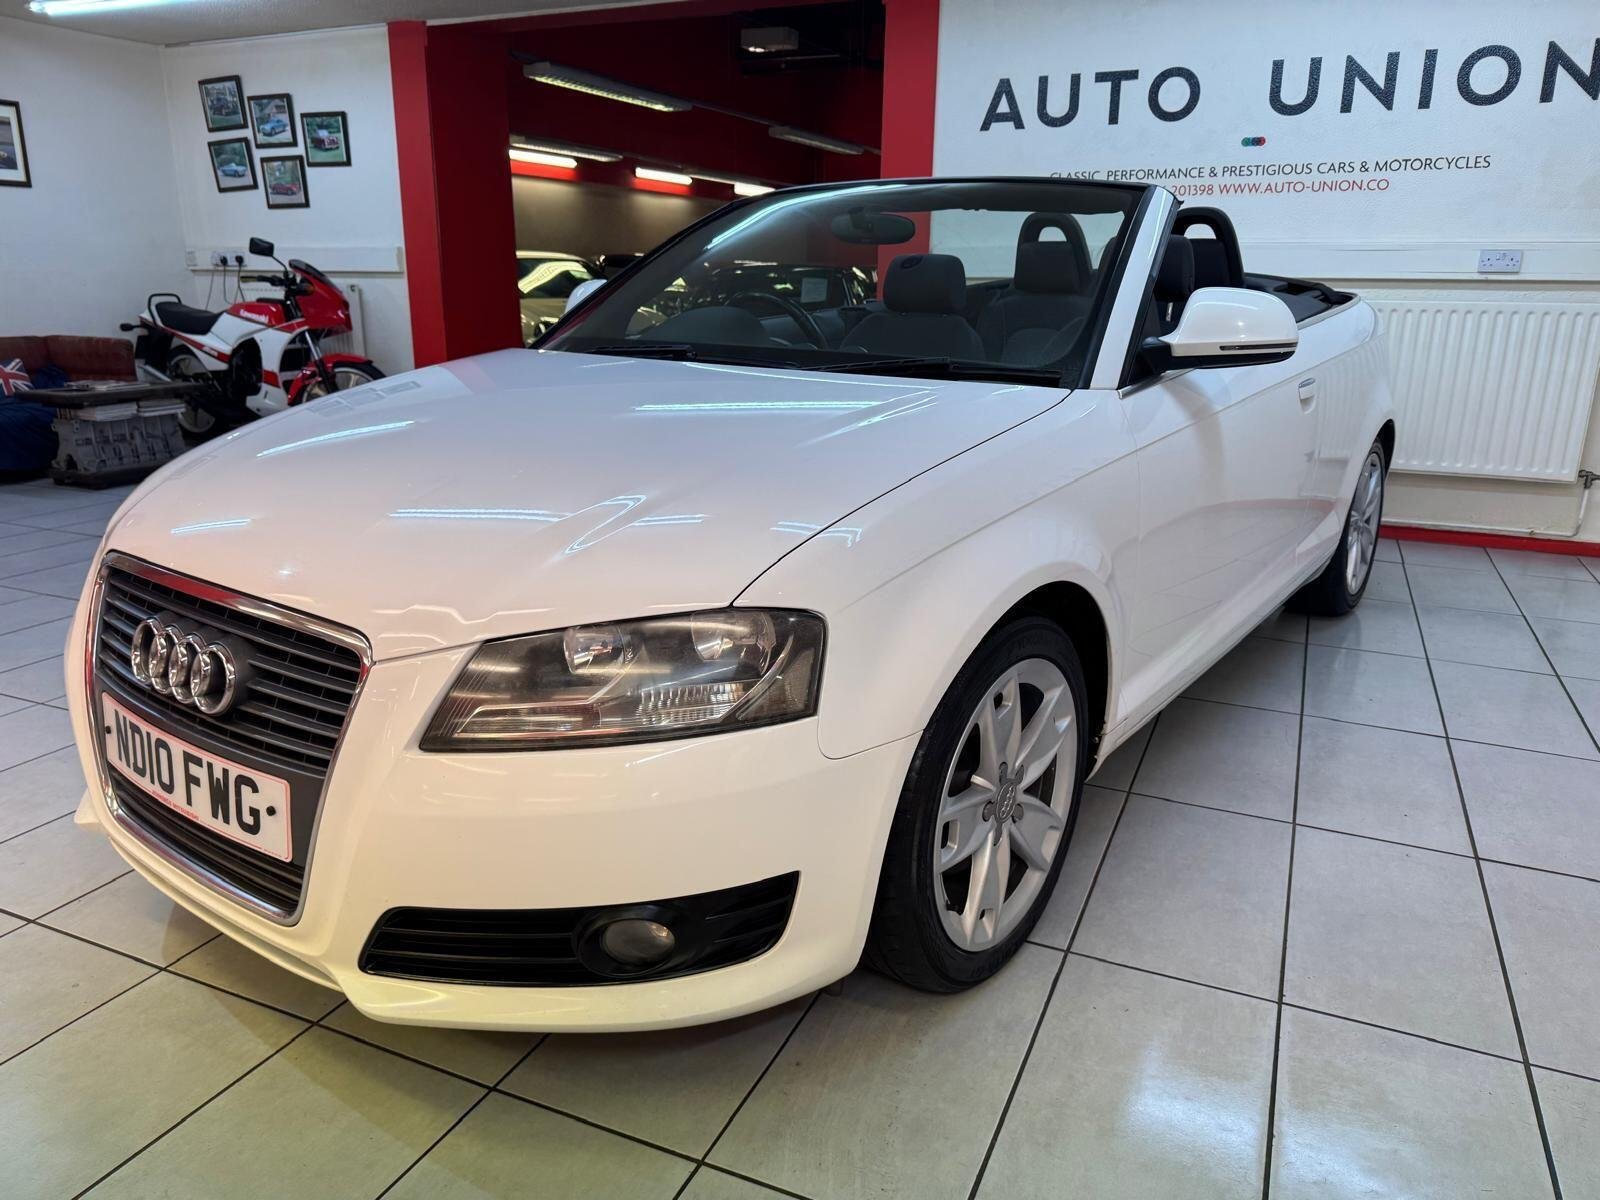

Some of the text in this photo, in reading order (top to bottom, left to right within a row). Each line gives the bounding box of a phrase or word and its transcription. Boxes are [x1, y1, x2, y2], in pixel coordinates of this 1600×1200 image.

[980, 36, 1600, 132] AUTO UNION
[1106, 166, 1206, 181] PERFORMANCE
[1208, 166, 1218, 178] &
[1221, 163, 1313, 178] PRESTIGIOUS
[1317, 161, 1355, 174] CARS
[1359, 160, 1370, 173] &
[1374, 155, 1491, 173] MOTORCYCLES
[1218, 178, 1390, 195] WWW.AUTO-UNION.CO
[114, 709, 261, 836] ND10 FWG
